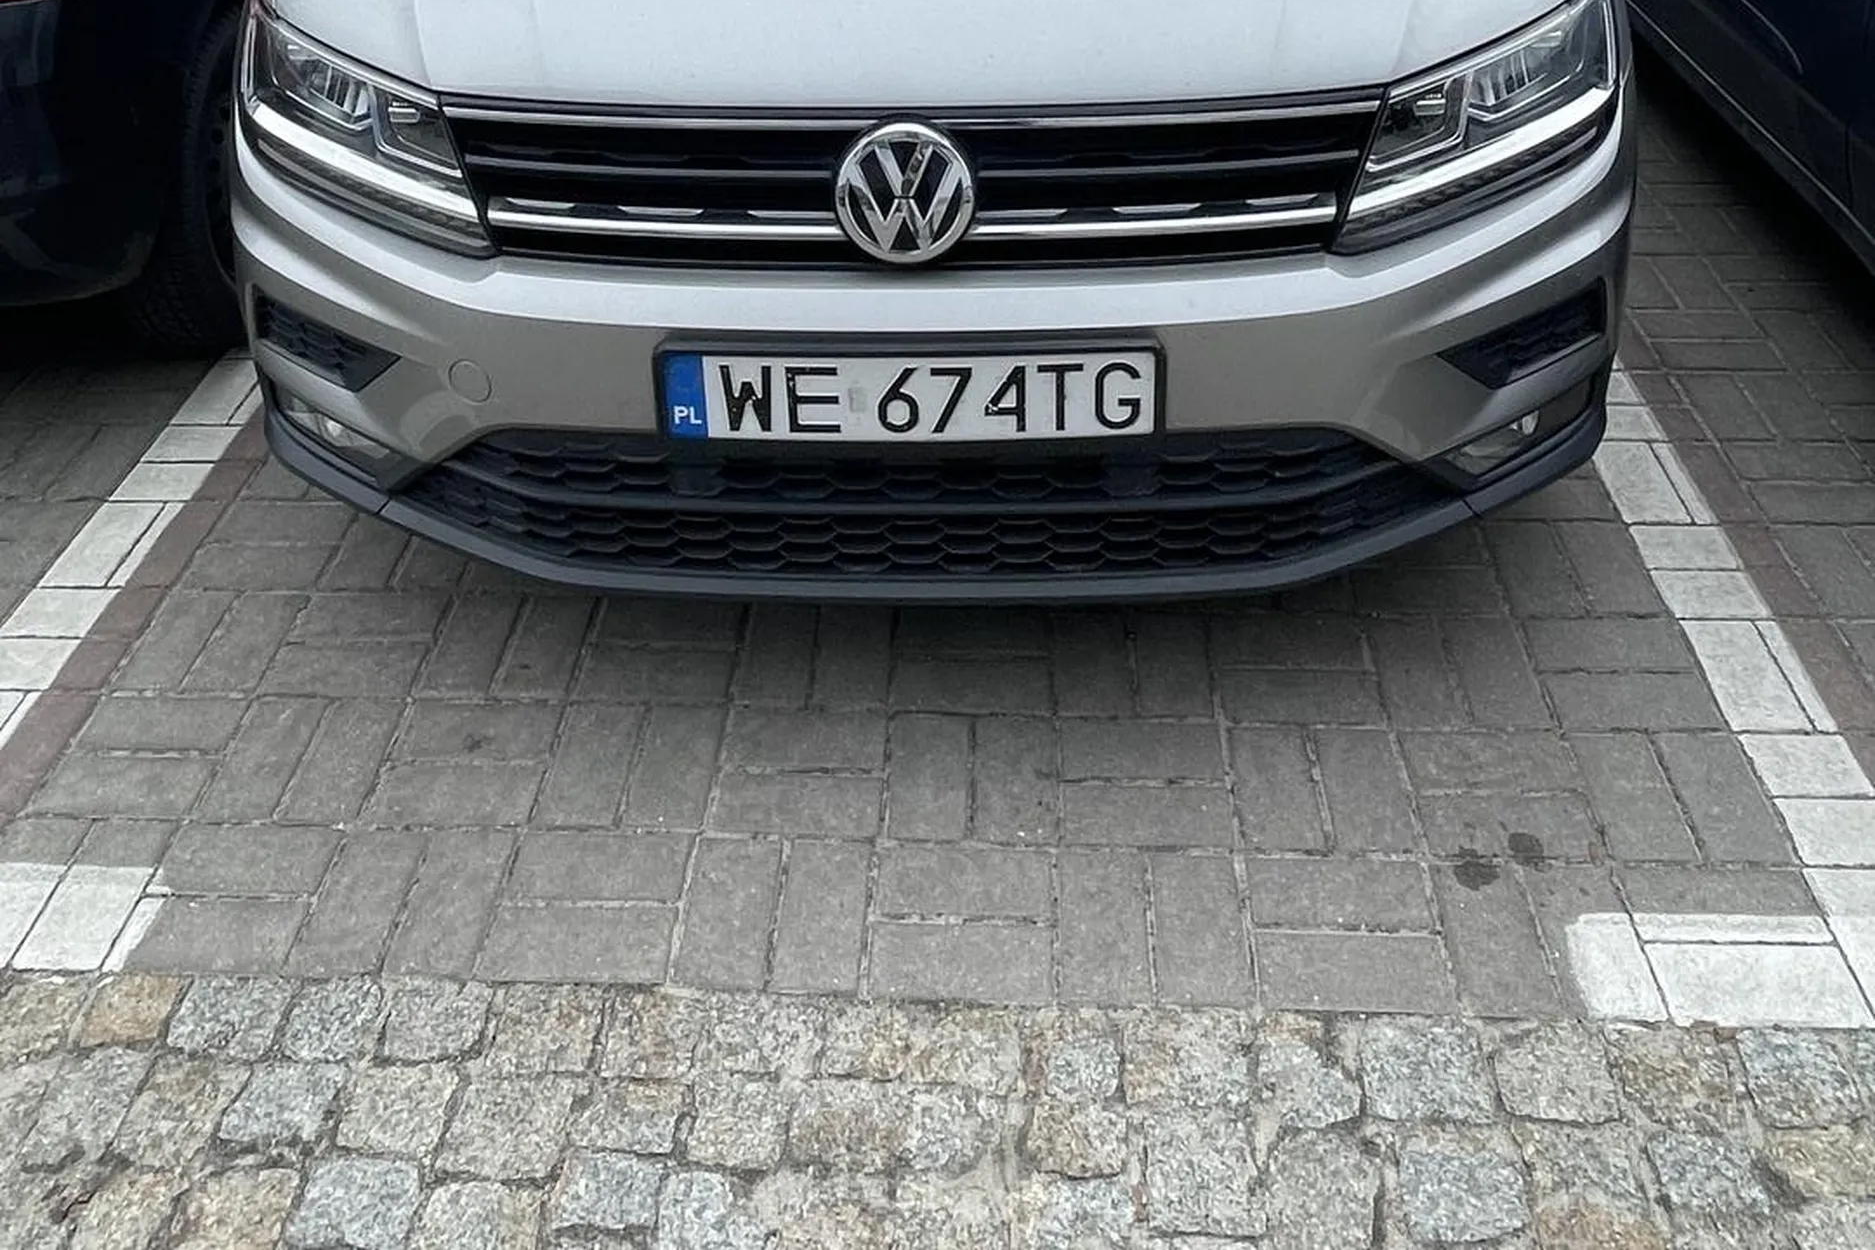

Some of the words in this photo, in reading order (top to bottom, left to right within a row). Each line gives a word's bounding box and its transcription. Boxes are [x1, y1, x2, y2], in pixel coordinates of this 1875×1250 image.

[847, 134, 965, 254] VW
[673, 405, 703, 425] PL
[718, 364, 842, 433] WE
[877, 362, 1142, 433] 674TG
